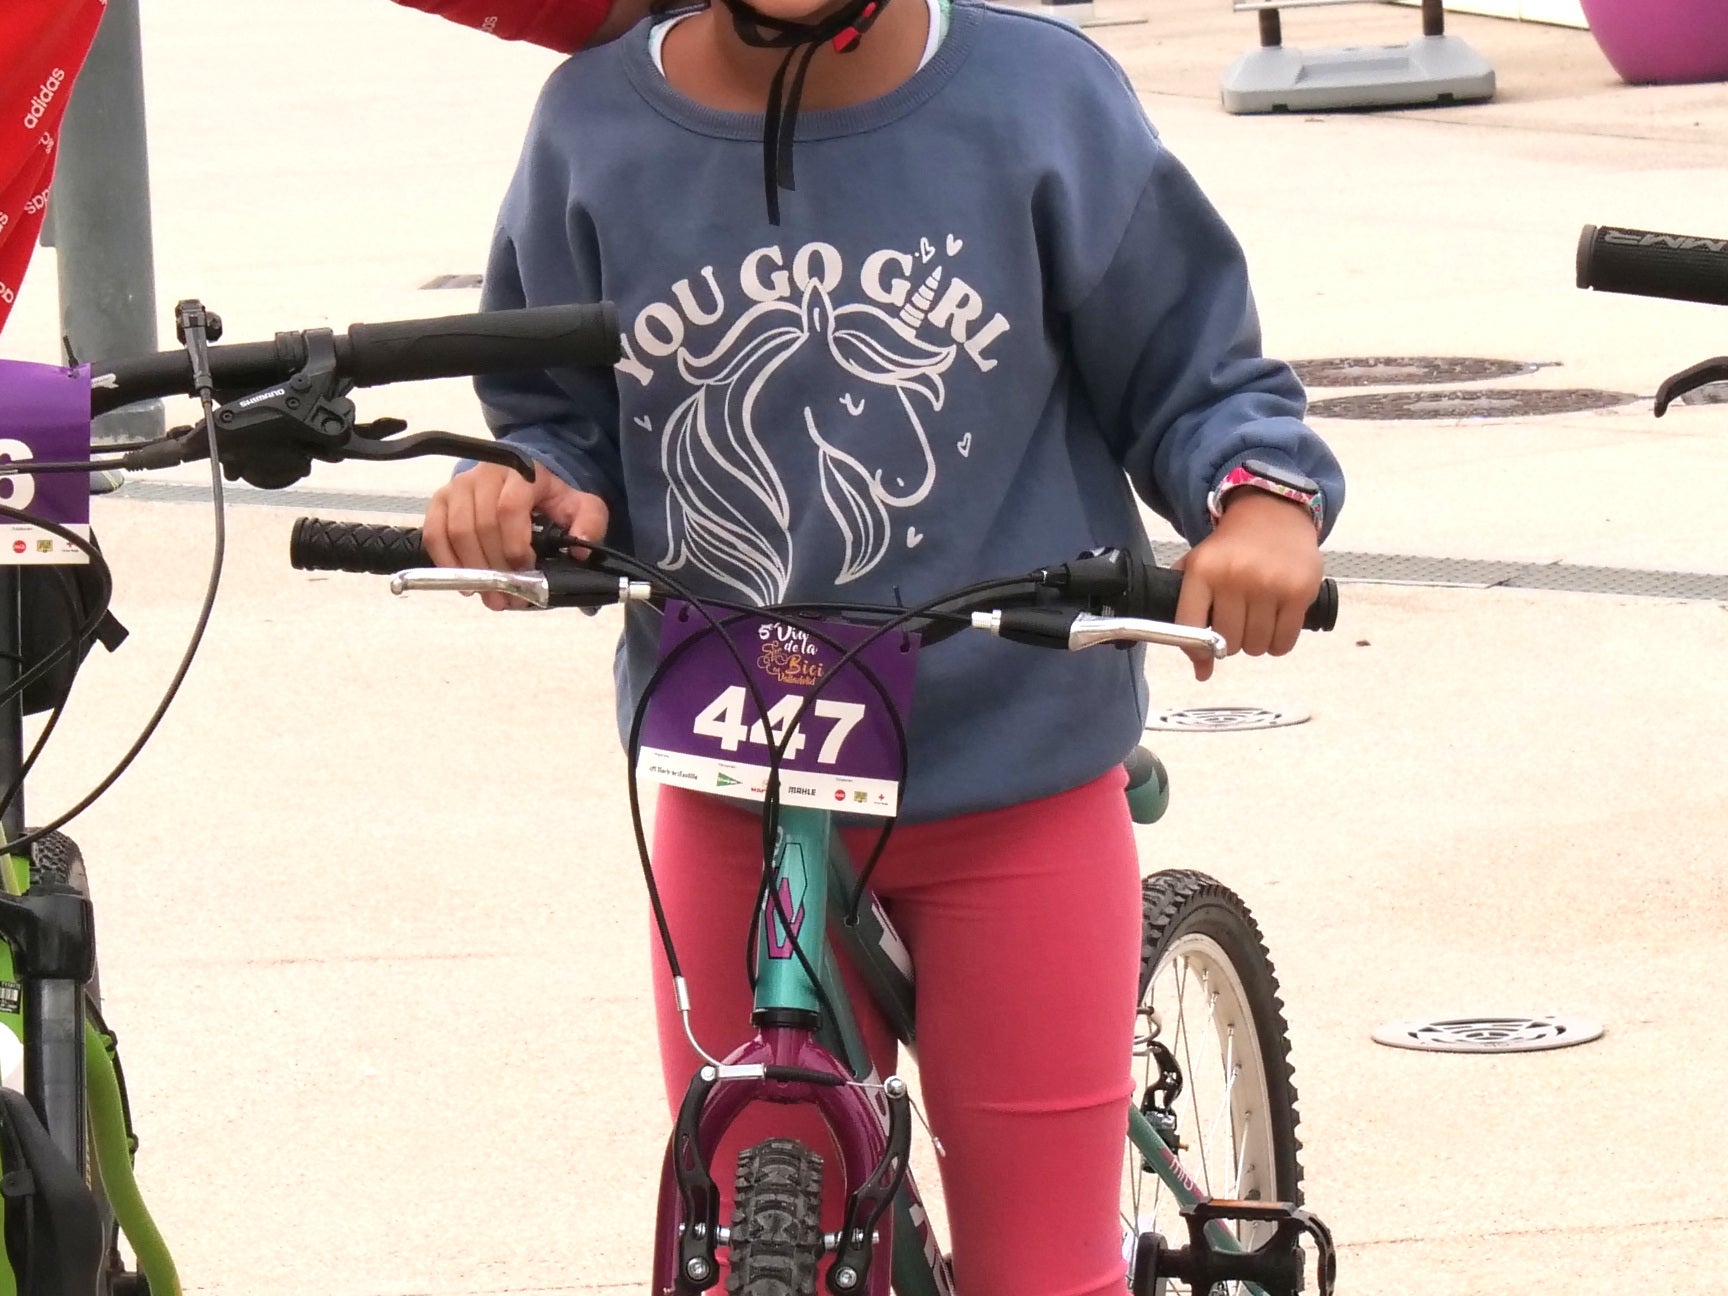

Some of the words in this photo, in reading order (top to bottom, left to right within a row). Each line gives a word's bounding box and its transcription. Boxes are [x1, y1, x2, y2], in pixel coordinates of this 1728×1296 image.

[24, 67, 65, 129] adidas
[615, 265, 725, 387] YOU
[739, 241, 843, 302] GO
[239, 387, 286, 408] SHIMANO
[693, 685, 866, 765] 447
[788, 786, 817, 796] MAHLE
